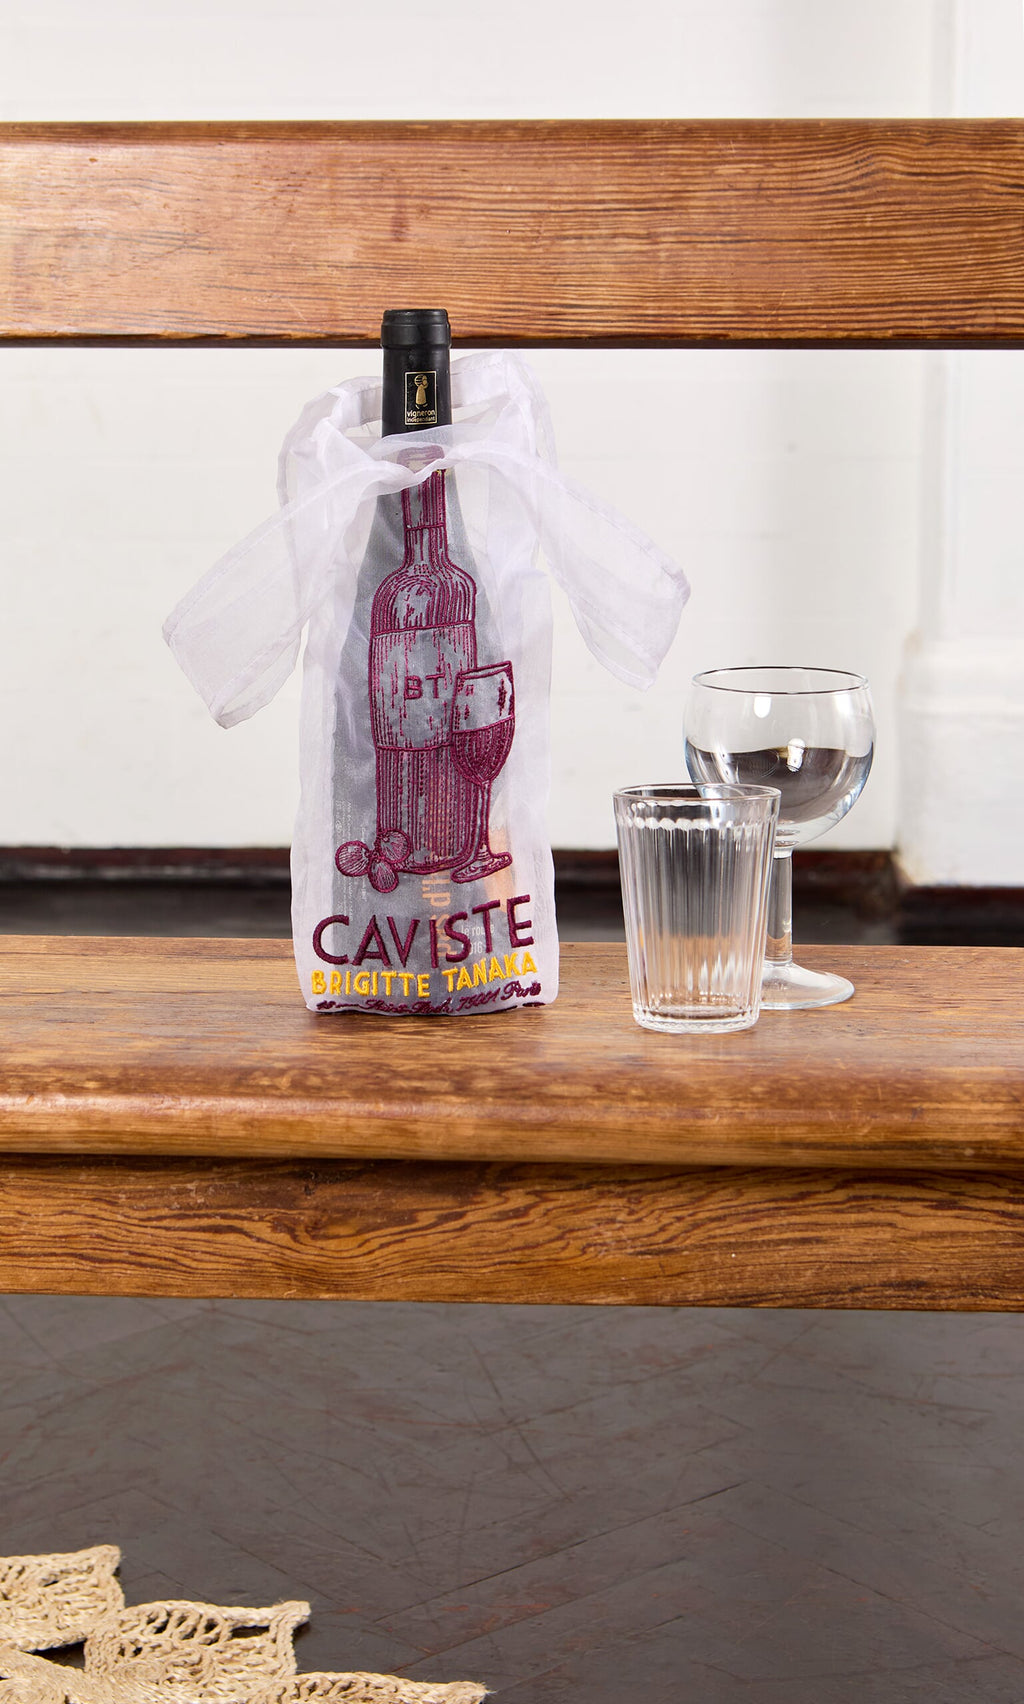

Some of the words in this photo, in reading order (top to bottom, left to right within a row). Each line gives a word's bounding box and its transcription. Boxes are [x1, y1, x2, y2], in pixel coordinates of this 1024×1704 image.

[407, 410, 436, 418] vigneron
[404, 674, 446, 700] BT
[312, 894, 535, 969] CAVISTE
[311, 969, 431, 998] BRIGITTE
[442, 951, 538, 992] TANAKA
[501, 980, 541, 1000] Paris
